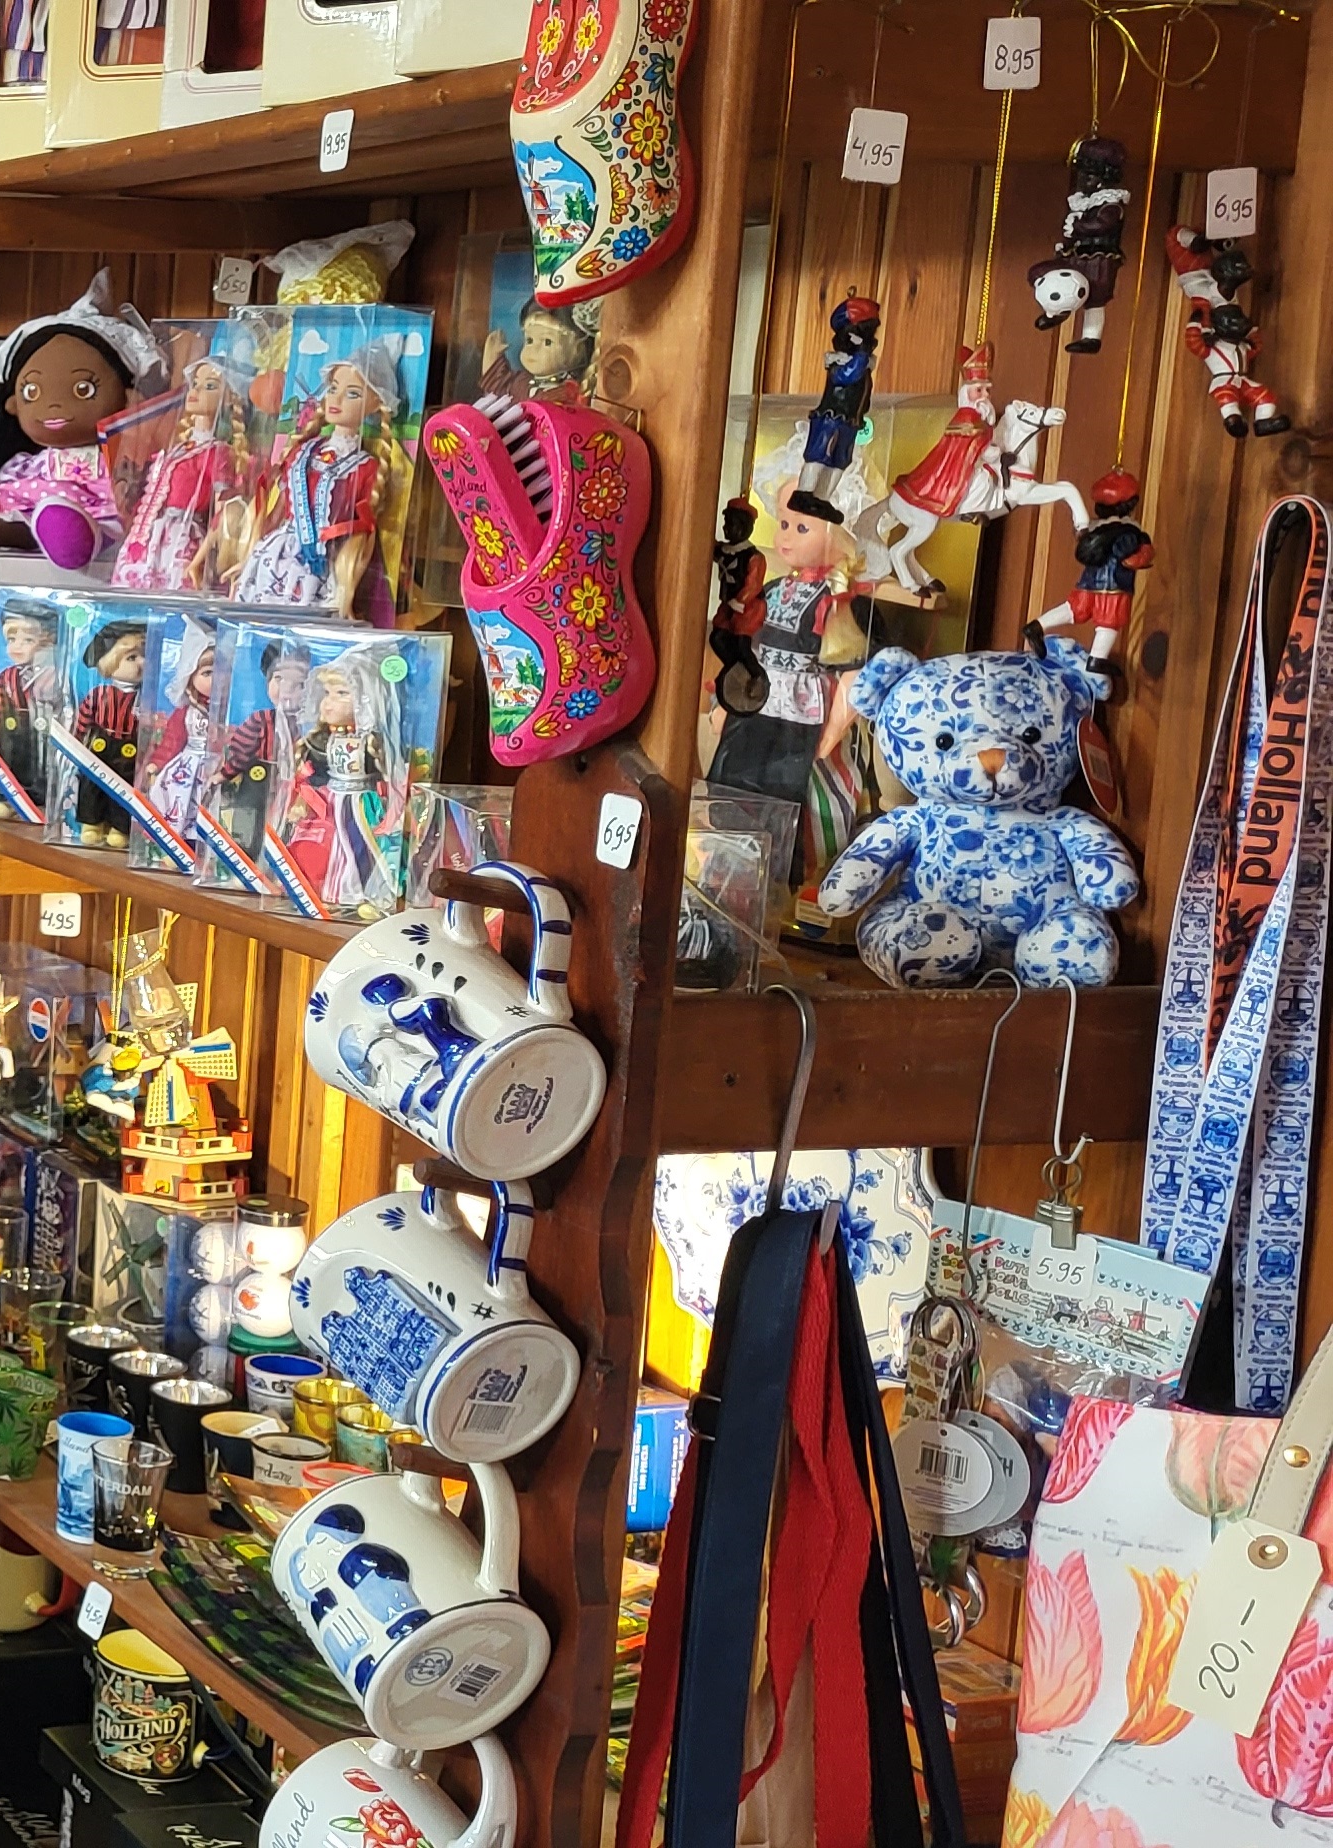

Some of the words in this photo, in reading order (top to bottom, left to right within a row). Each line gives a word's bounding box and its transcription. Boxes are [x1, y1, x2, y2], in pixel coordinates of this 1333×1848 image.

[995, 43, 1041, 74] 8,95
[852, 137, 901, 167] 4,95
[1214, 194, 1254, 223] 6,95
[1236, 711, 1306, 888] Holland
[986, 1267, 1034, 1292] SOUVE
[994, 1256, 1030, 1276] DUTC
[1035, 1256, 1087, 1286] 5,95
[99, 1716, 176, 1742] HOLLAND
